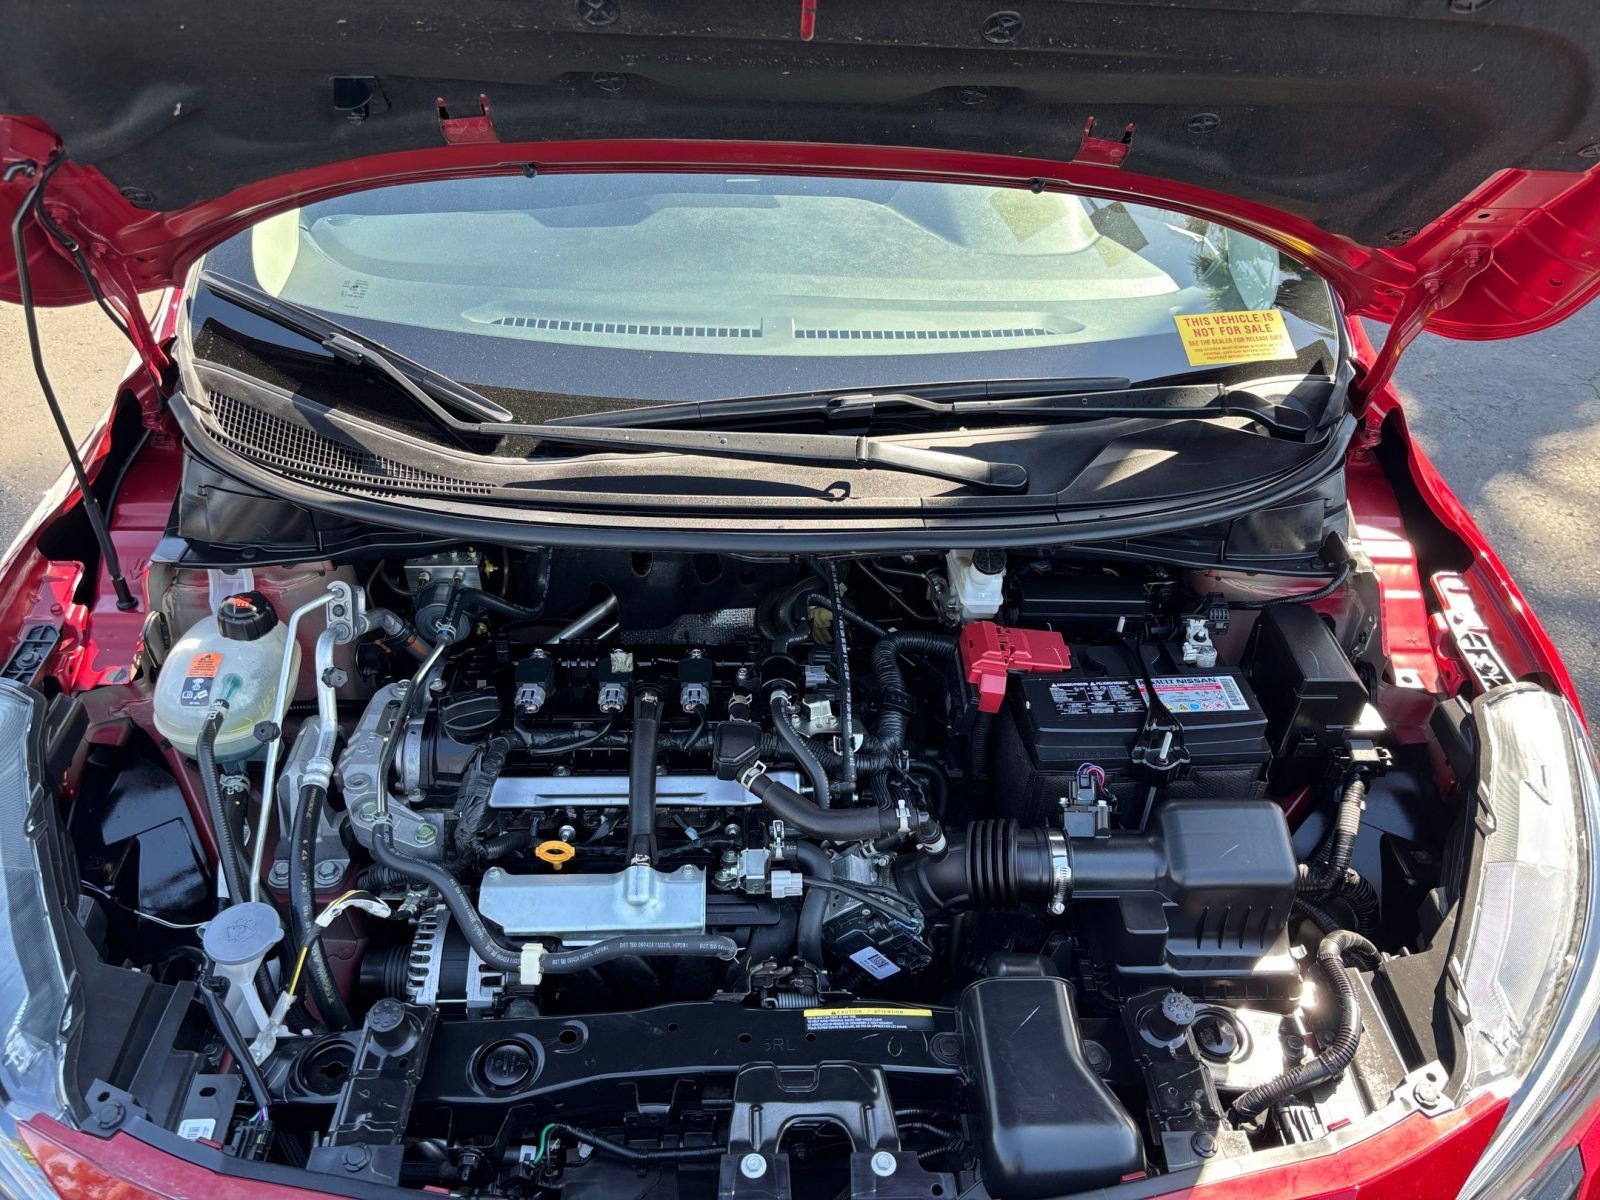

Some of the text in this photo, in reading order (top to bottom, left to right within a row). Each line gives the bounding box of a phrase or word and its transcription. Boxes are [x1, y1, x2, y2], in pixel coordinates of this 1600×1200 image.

[1184, 312, 1274, 327] THIS VEHICLE IS
[1193, 324, 1273, 338] NOT FOR SALE
